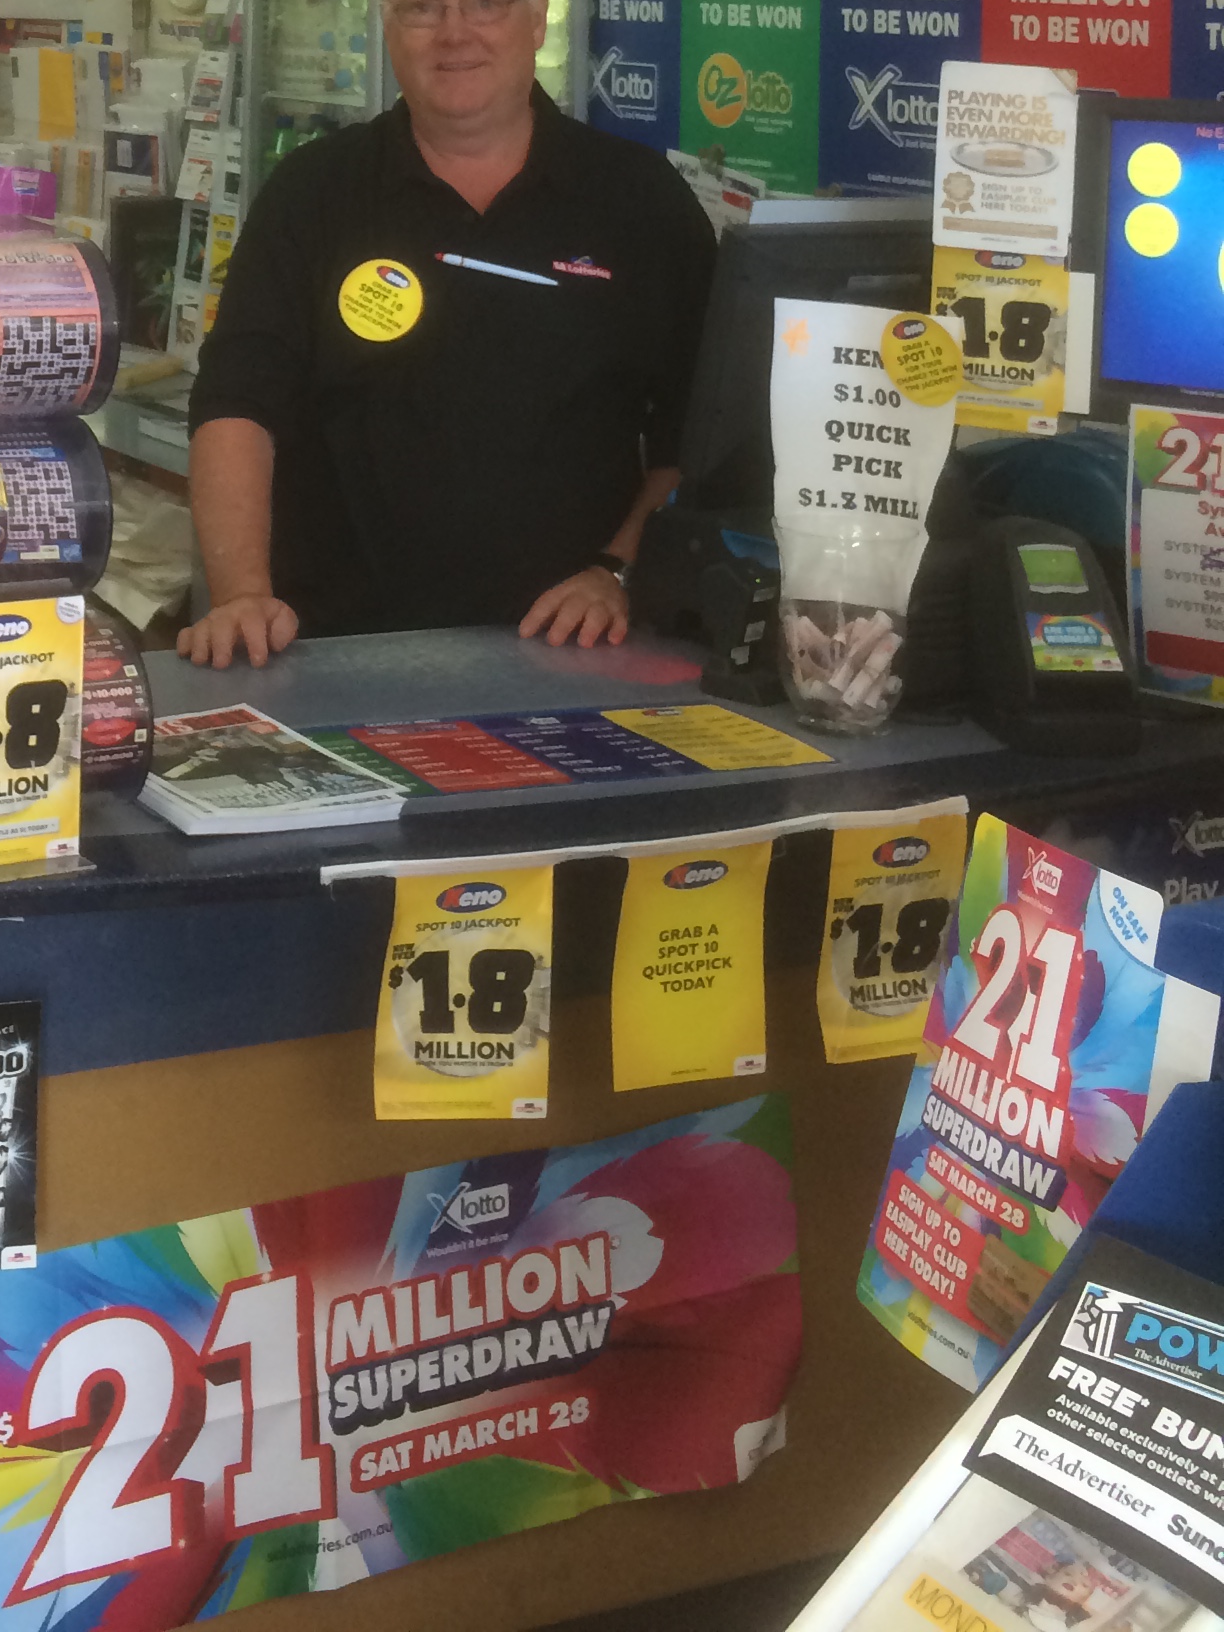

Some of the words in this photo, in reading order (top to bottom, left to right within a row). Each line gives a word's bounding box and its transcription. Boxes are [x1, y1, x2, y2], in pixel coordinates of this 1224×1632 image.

[700, 4, 722, 26] TO
[728, 6, 752, 28] BE
[756, 7, 802, 29] WON
[841, 9, 867, 33] TO
[875, 10, 902, 35] BE
[908, 10, 960, 37] WON
[1010, 17, 1040, 42] TO
[1048, 18, 1079, 44] BE
[1087, 19, 1149, 46] WON
[947, 89, 1026, 109] PLAYING
[1032, 96, 1047, 111] IS
[947, 106, 993, 123] EVEN
[998, 110, 1054, 128] MORE
[945, 122, 1066, 145] REWARDING!
[834, 382, 901, 410] $1.00
[824, 419, 911, 448] QUICK
[832, 453, 903, 480] PICK
[659, 927, 702, 944] GRAB
[707, 925, 719, 937] A
[658, 944, 700, 959] SPOT
[704, 941, 719, 955] 10
[642, 957, 733, 980] QUICKPICK
[660, 975, 716, 994] TODAY
[414, 1040, 515, 1062] MILLION
[930, 1046, 1065, 1158] MILLION
[925, 1095, 1057, 1201] SUPERDRAW
[327, 1232, 613, 1366] MILLION
[330, 1309, 609, 1420] SUPERDRAW
[359, 1444, 414, 1485] SAT
[422, 1414, 538, 1466] MARCH
[548, 1395, 591, 1429] 28
[1012, 1429, 1049, 1464] The
[1048, 1452, 1156, 1520] Advertiser
